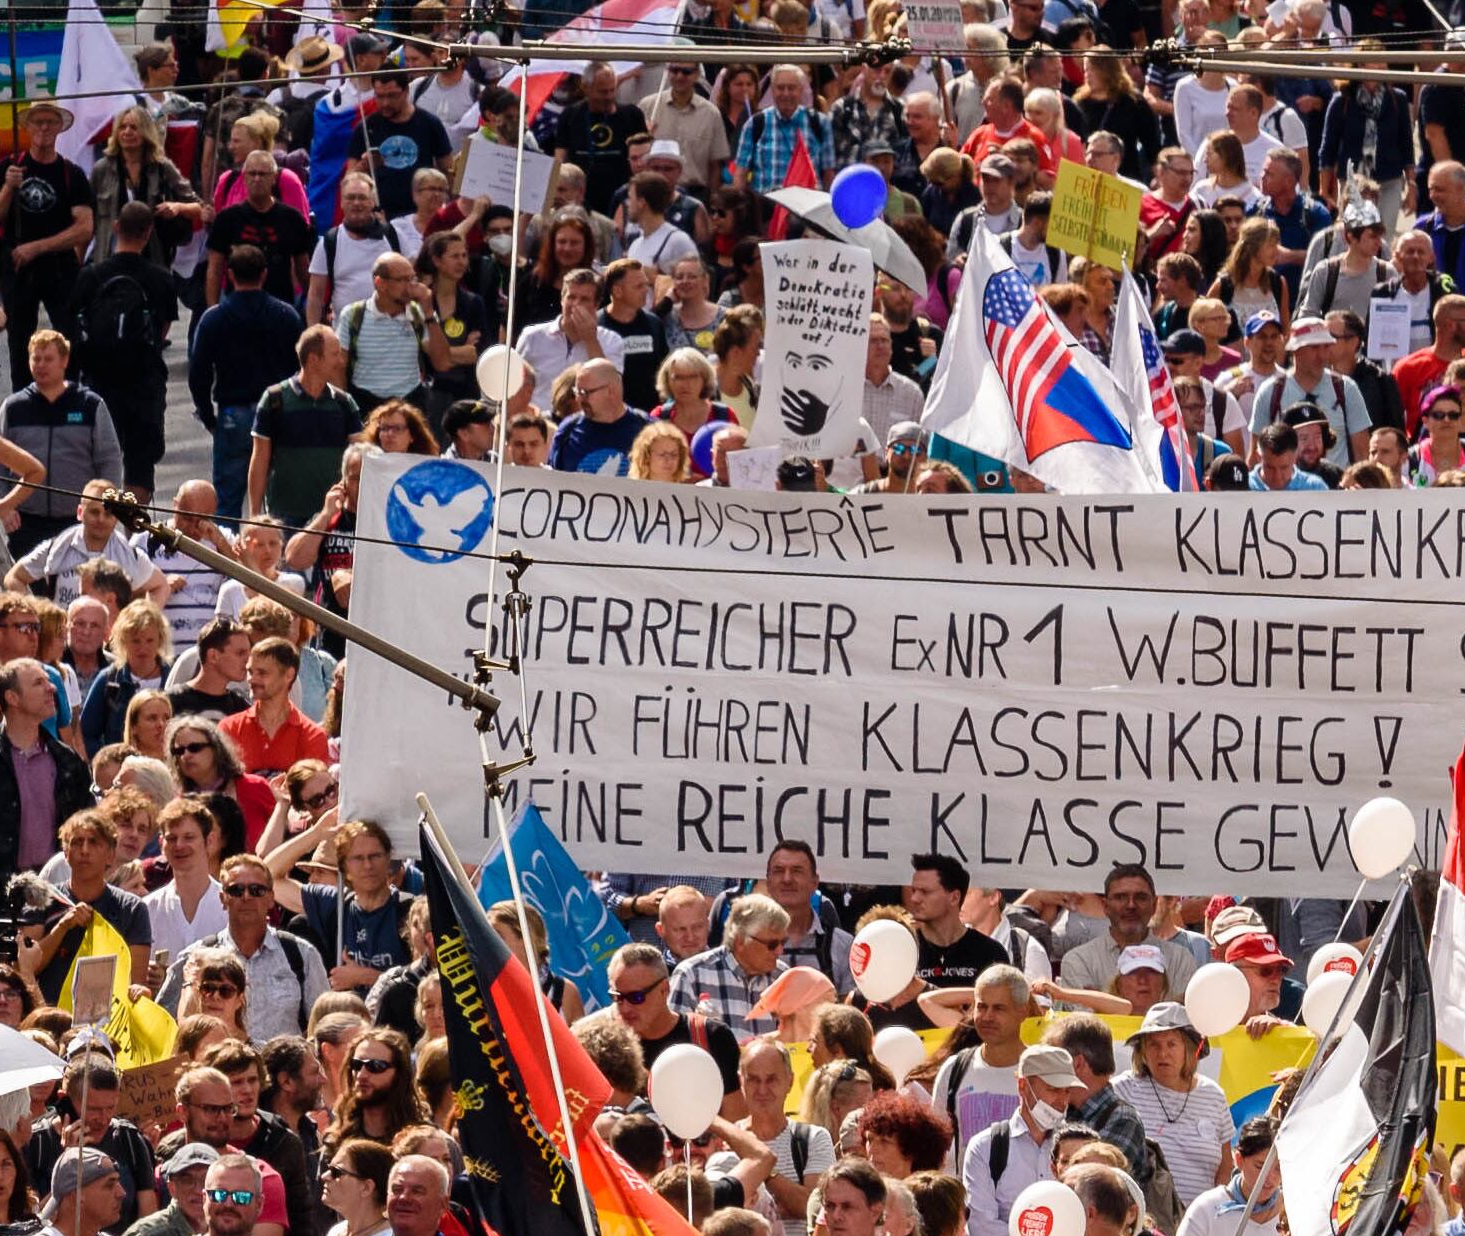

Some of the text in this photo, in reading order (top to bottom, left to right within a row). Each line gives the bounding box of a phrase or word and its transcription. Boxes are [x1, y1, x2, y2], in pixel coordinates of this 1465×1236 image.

[1062, 197, 1109, 227] FREIHIT
[1074, 176, 1128, 212] FRIDEN
[807, 256, 819, 270] in
[829, 252, 857, 273] der
[928, 504, 1135, 572] TARNT
[1107, 607, 1424, 693] W.BUFFETT
[632, 684, 810, 766] FÜHREN
[677, 776, 891, 861] REICHE
[932, 791, 1186, 871] KLASSE
